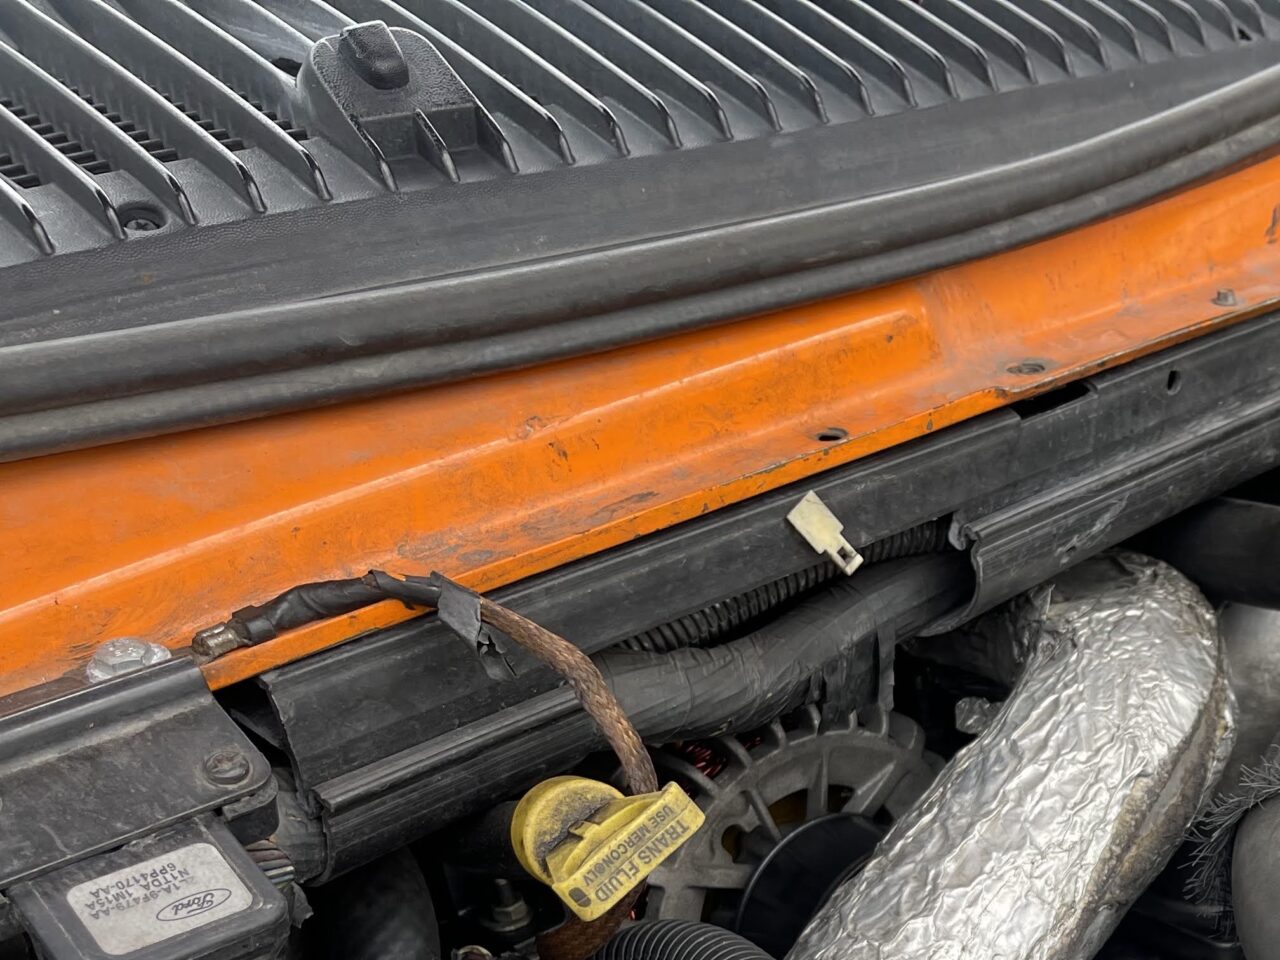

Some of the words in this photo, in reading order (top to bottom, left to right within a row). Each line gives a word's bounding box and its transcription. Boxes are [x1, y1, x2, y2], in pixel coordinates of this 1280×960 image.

[648, 804, 674, 829] USE
[637, 819, 689, 865] TRANS
[90, 862, 176, 898] 6PP4170-AA
[139, 868, 189, 891] N1TDA
[594, 860, 639, 902] FLUID
[170, 892, 216, 916] Ford
